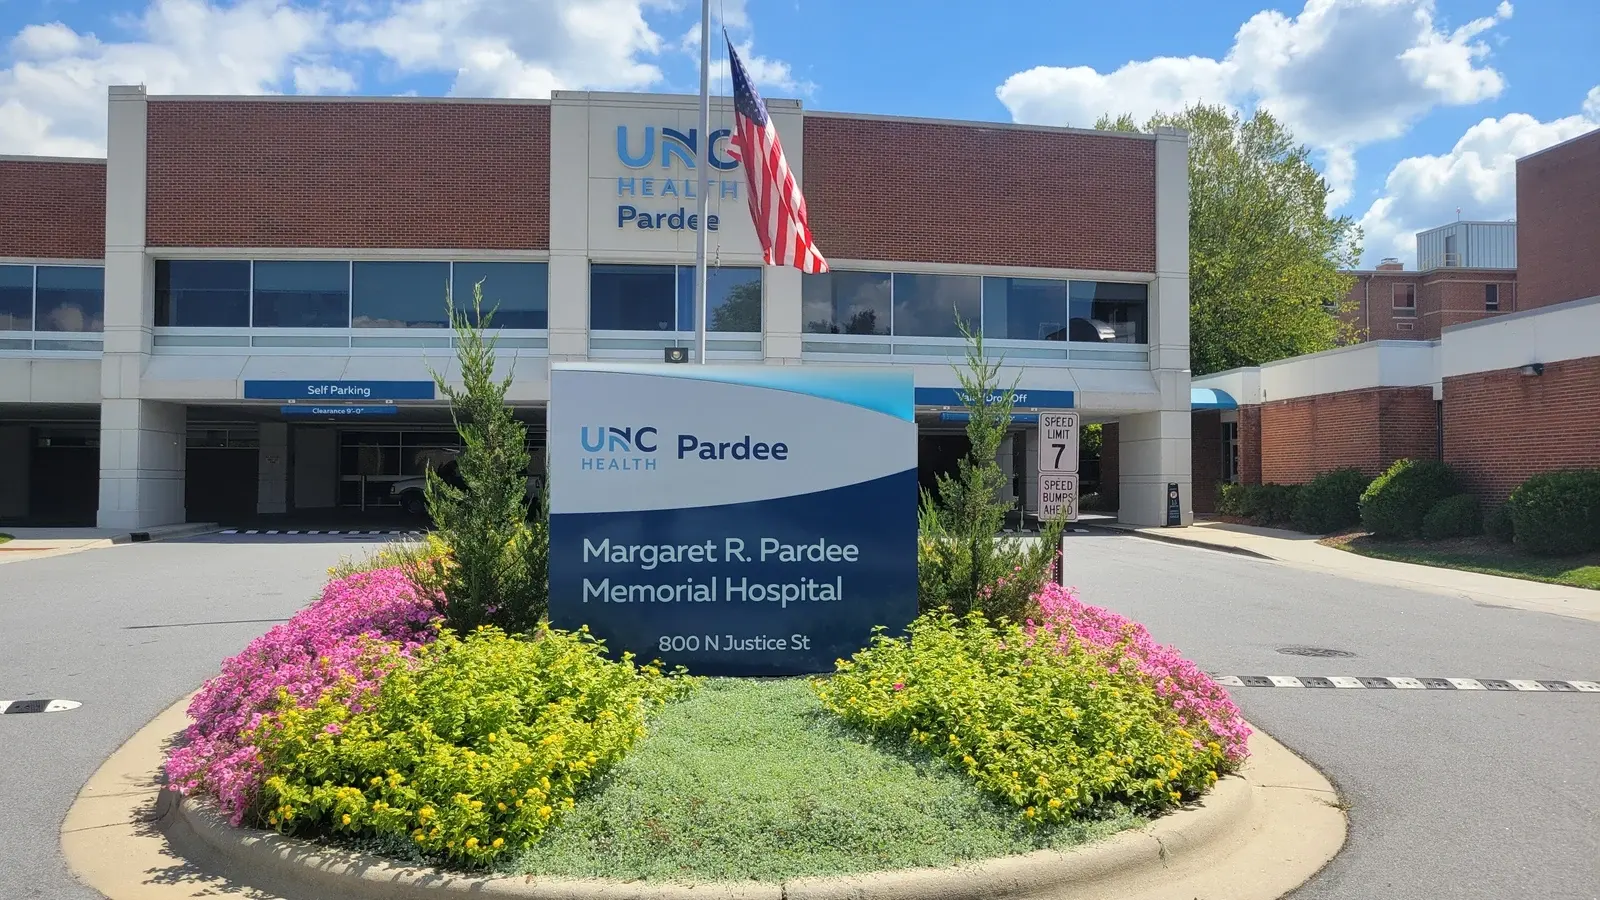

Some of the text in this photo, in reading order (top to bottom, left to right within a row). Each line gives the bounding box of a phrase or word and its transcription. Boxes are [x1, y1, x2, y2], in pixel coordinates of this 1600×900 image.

[617, 125, 740, 170] UNC
[618, 205, 719, 230] Pardee
[307, 385, 371, 397] Self Parking
[1044, 416, 1074, 427] SPEED
[581, 426, 789, 460] UNC Pardee
[1047, 429, 1070, 439] LIMIT
[581, 458, 656, 470] HEALTH
[1051, 443, 1066, 469] 7
[1044, 480, 1073, 491] SPEED
[1043, 493, 1073, 503] BUMPS
[582, 537, 860, 570] Margaret R. Pardee
[582, 575, 843, 609] Memorial Hospital
[658, 634, 811, 652] 800 N Justice St
